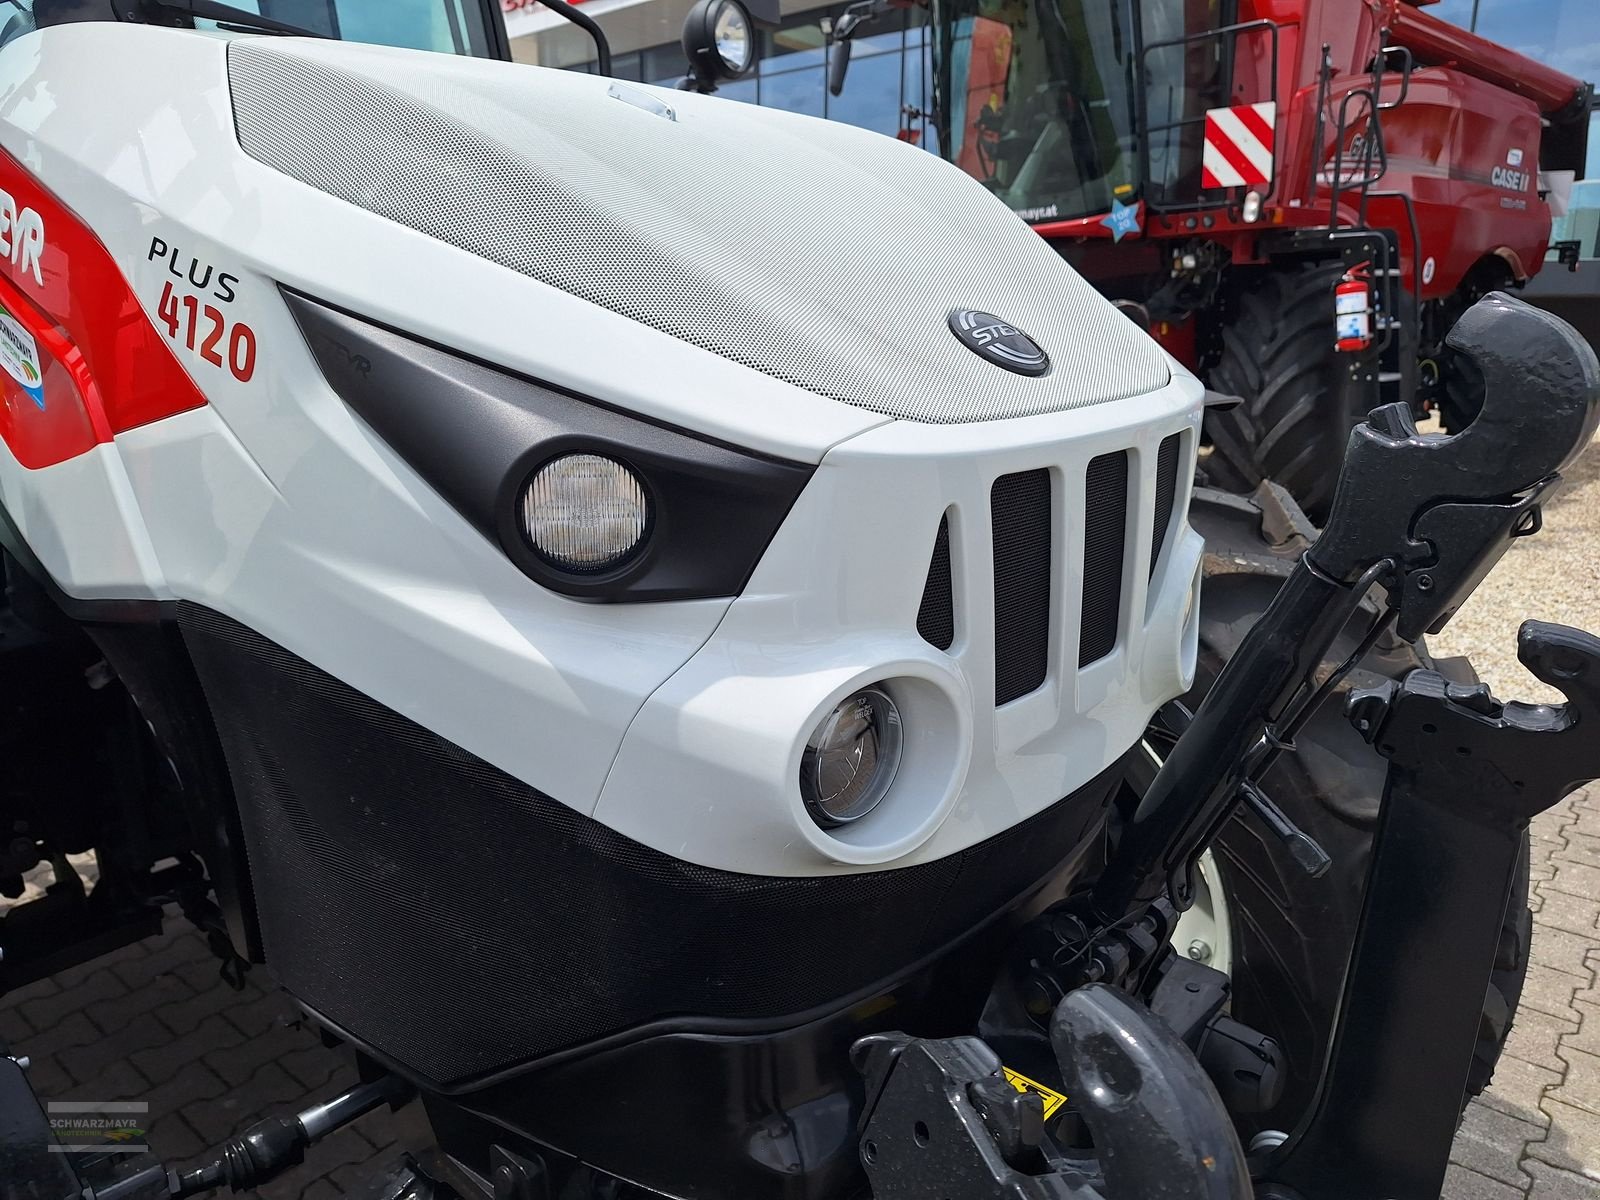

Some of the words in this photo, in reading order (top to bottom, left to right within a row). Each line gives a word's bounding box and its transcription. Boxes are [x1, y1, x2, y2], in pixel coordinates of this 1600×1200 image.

[1492, 166, 1520, 191] CASE
[148, 236, 239, 303] PLUS
[157, 281, 257, 383] 4120
